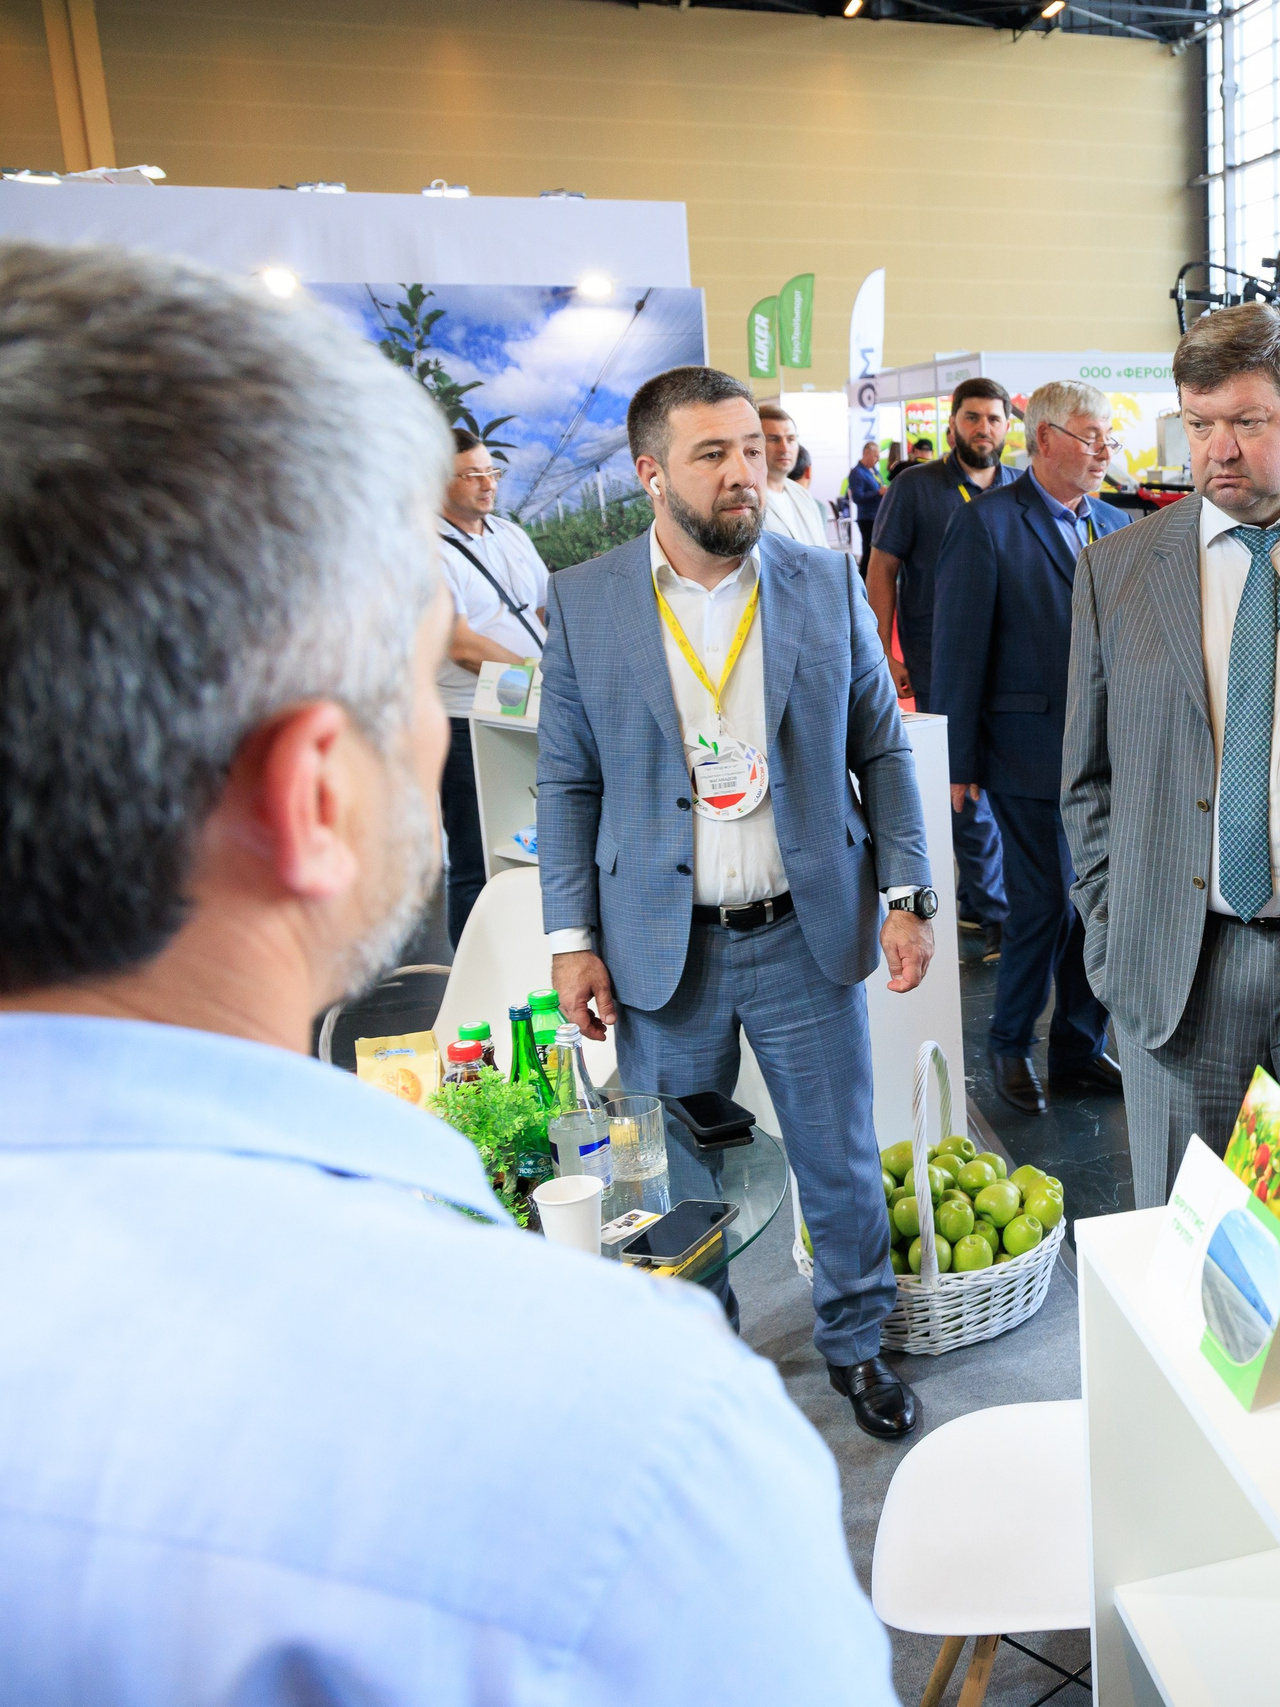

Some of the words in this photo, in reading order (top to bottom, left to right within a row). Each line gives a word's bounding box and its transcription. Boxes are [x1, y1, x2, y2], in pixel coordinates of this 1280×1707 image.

[754, 313, 770, 373] KUKER
[1079, 366, 1112, 379] ООО
[1116, 366, 1174, 379] «ФЕРОЛ
